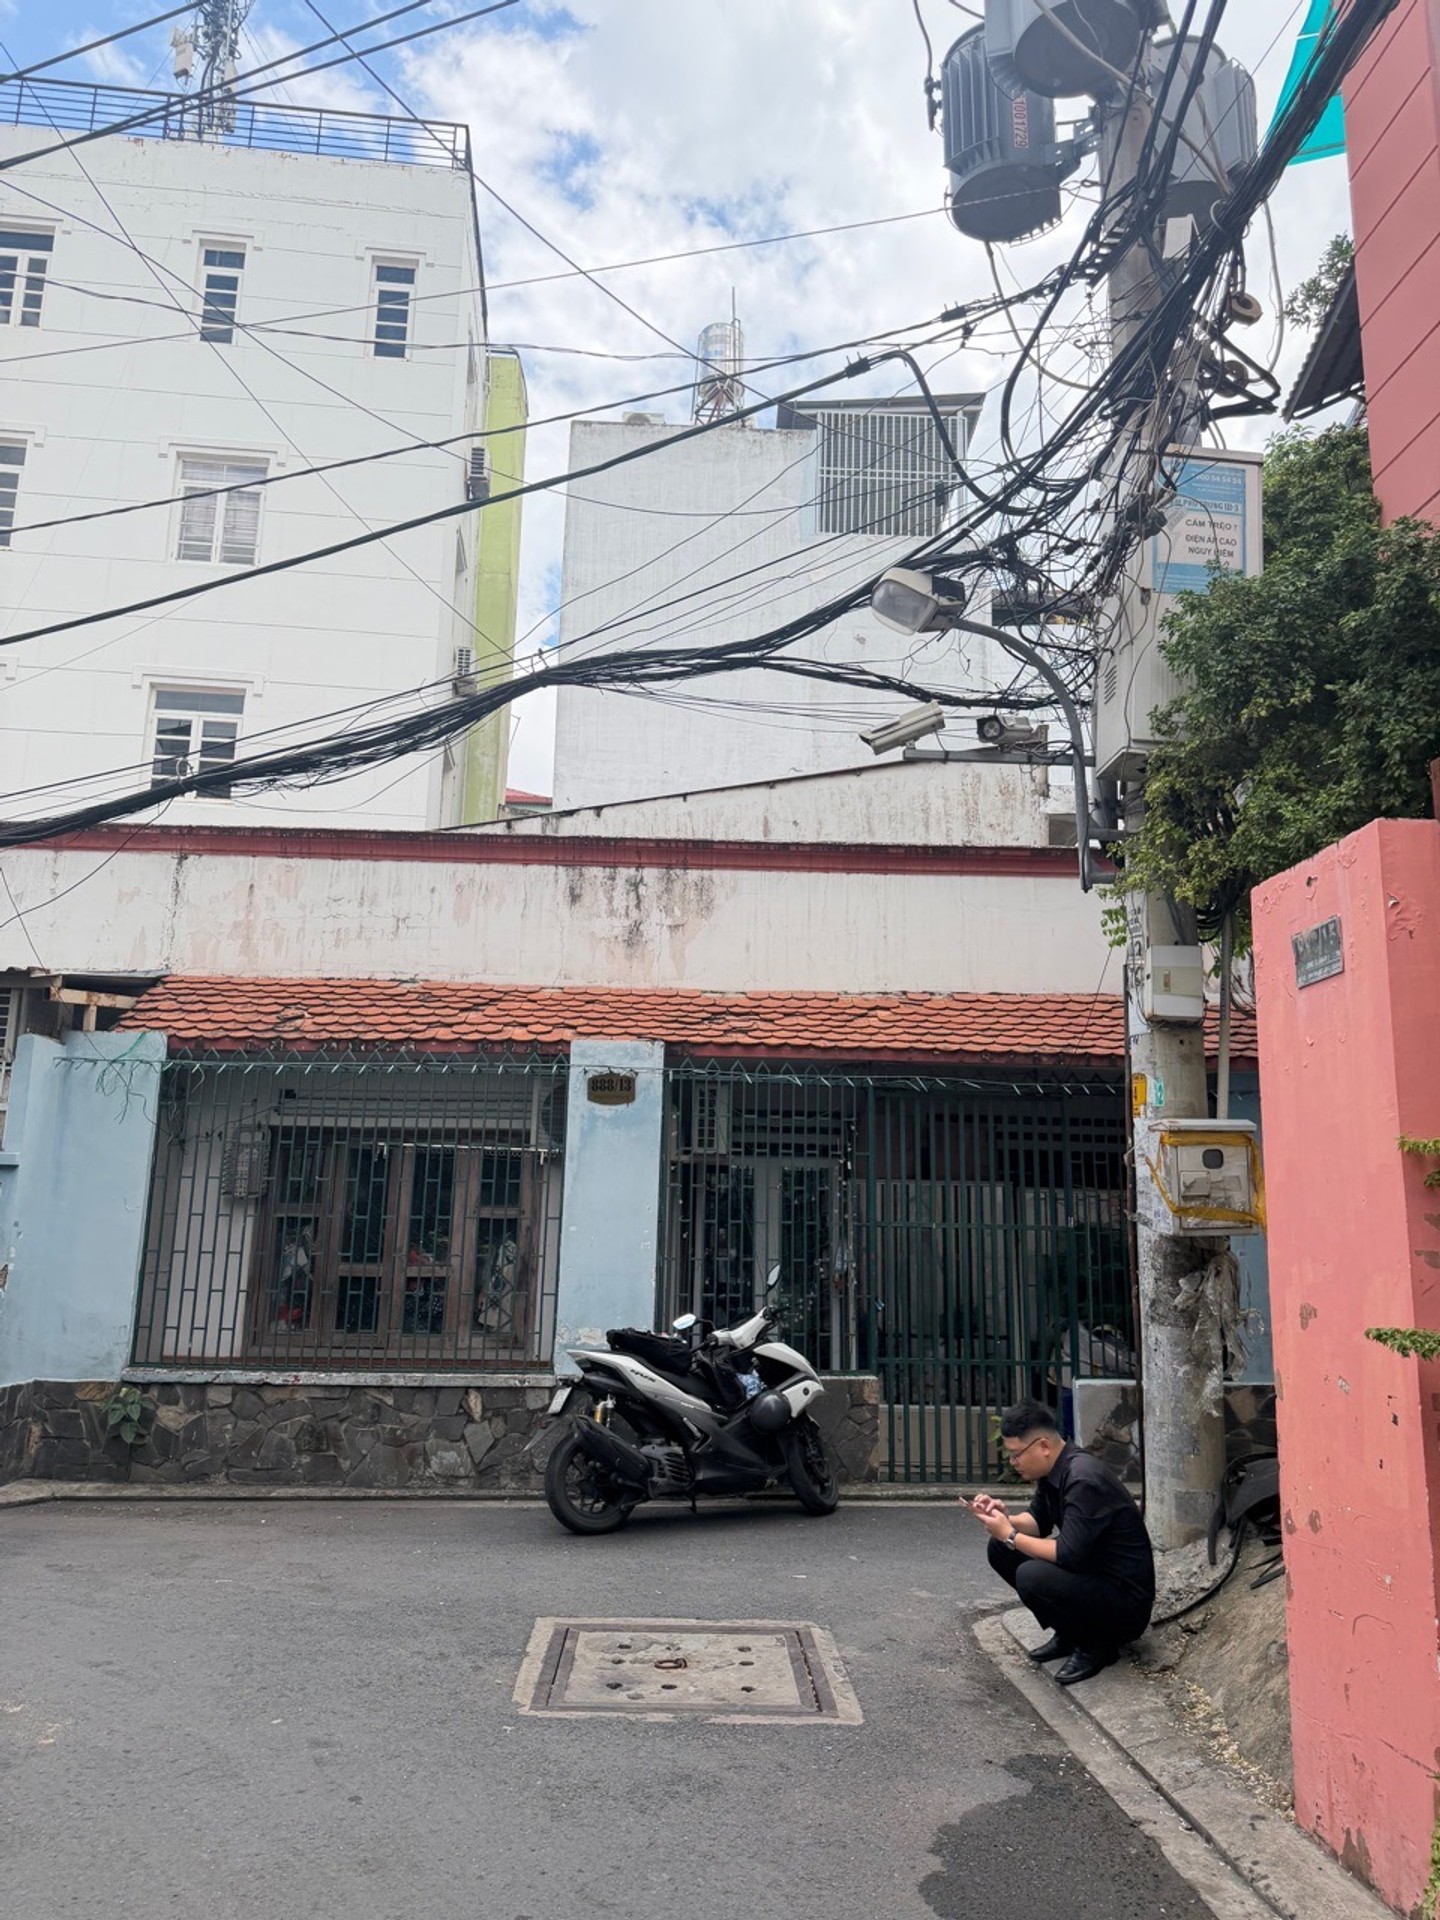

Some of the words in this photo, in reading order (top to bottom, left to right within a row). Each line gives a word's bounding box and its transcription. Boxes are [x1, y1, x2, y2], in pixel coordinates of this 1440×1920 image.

[1219, 536, 1238, 546] CAO
[1188, 547, 1212, 556] NGUY
[591, 1078, 632, 1092] 888/13
